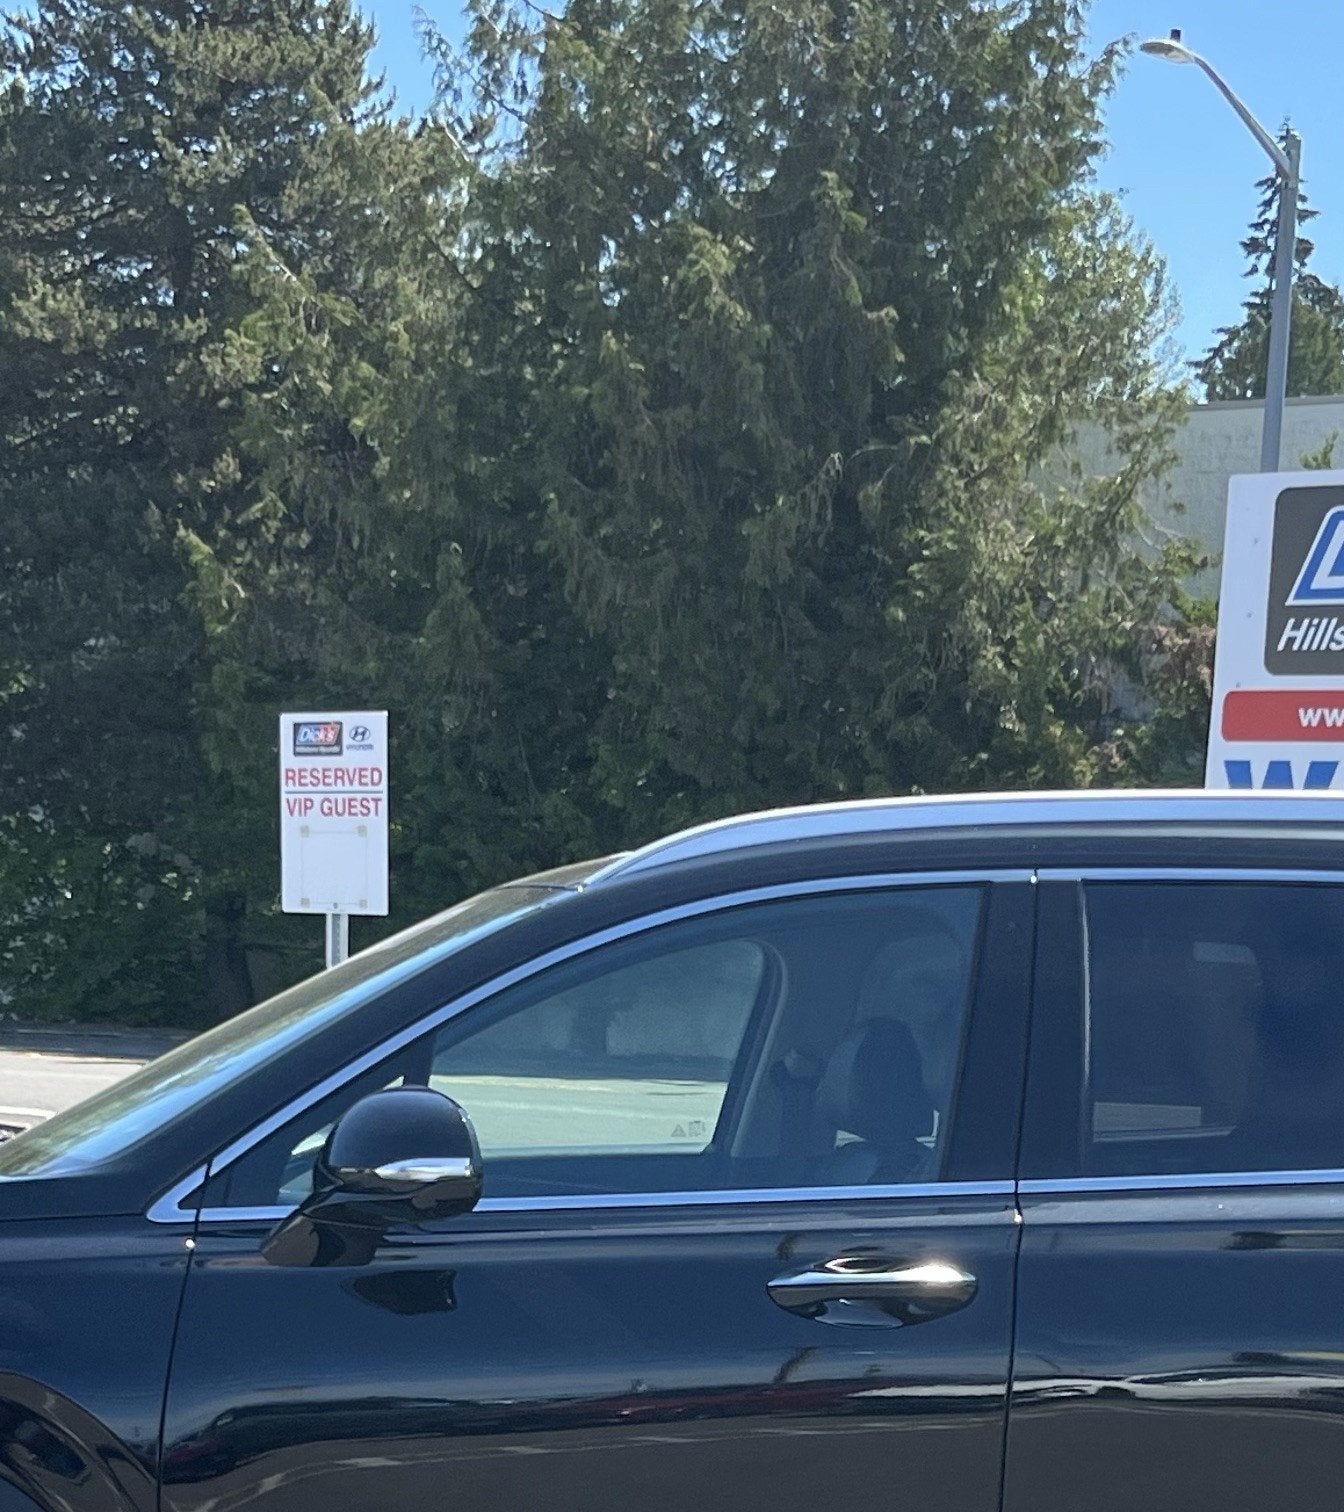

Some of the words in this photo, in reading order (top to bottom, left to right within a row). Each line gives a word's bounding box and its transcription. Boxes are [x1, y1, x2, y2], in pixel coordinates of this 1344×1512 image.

[285, 767, 383, 787] RESERVED
[286, 797, 314, 817] VIP
[320, 797, 382, 817] GUEST
